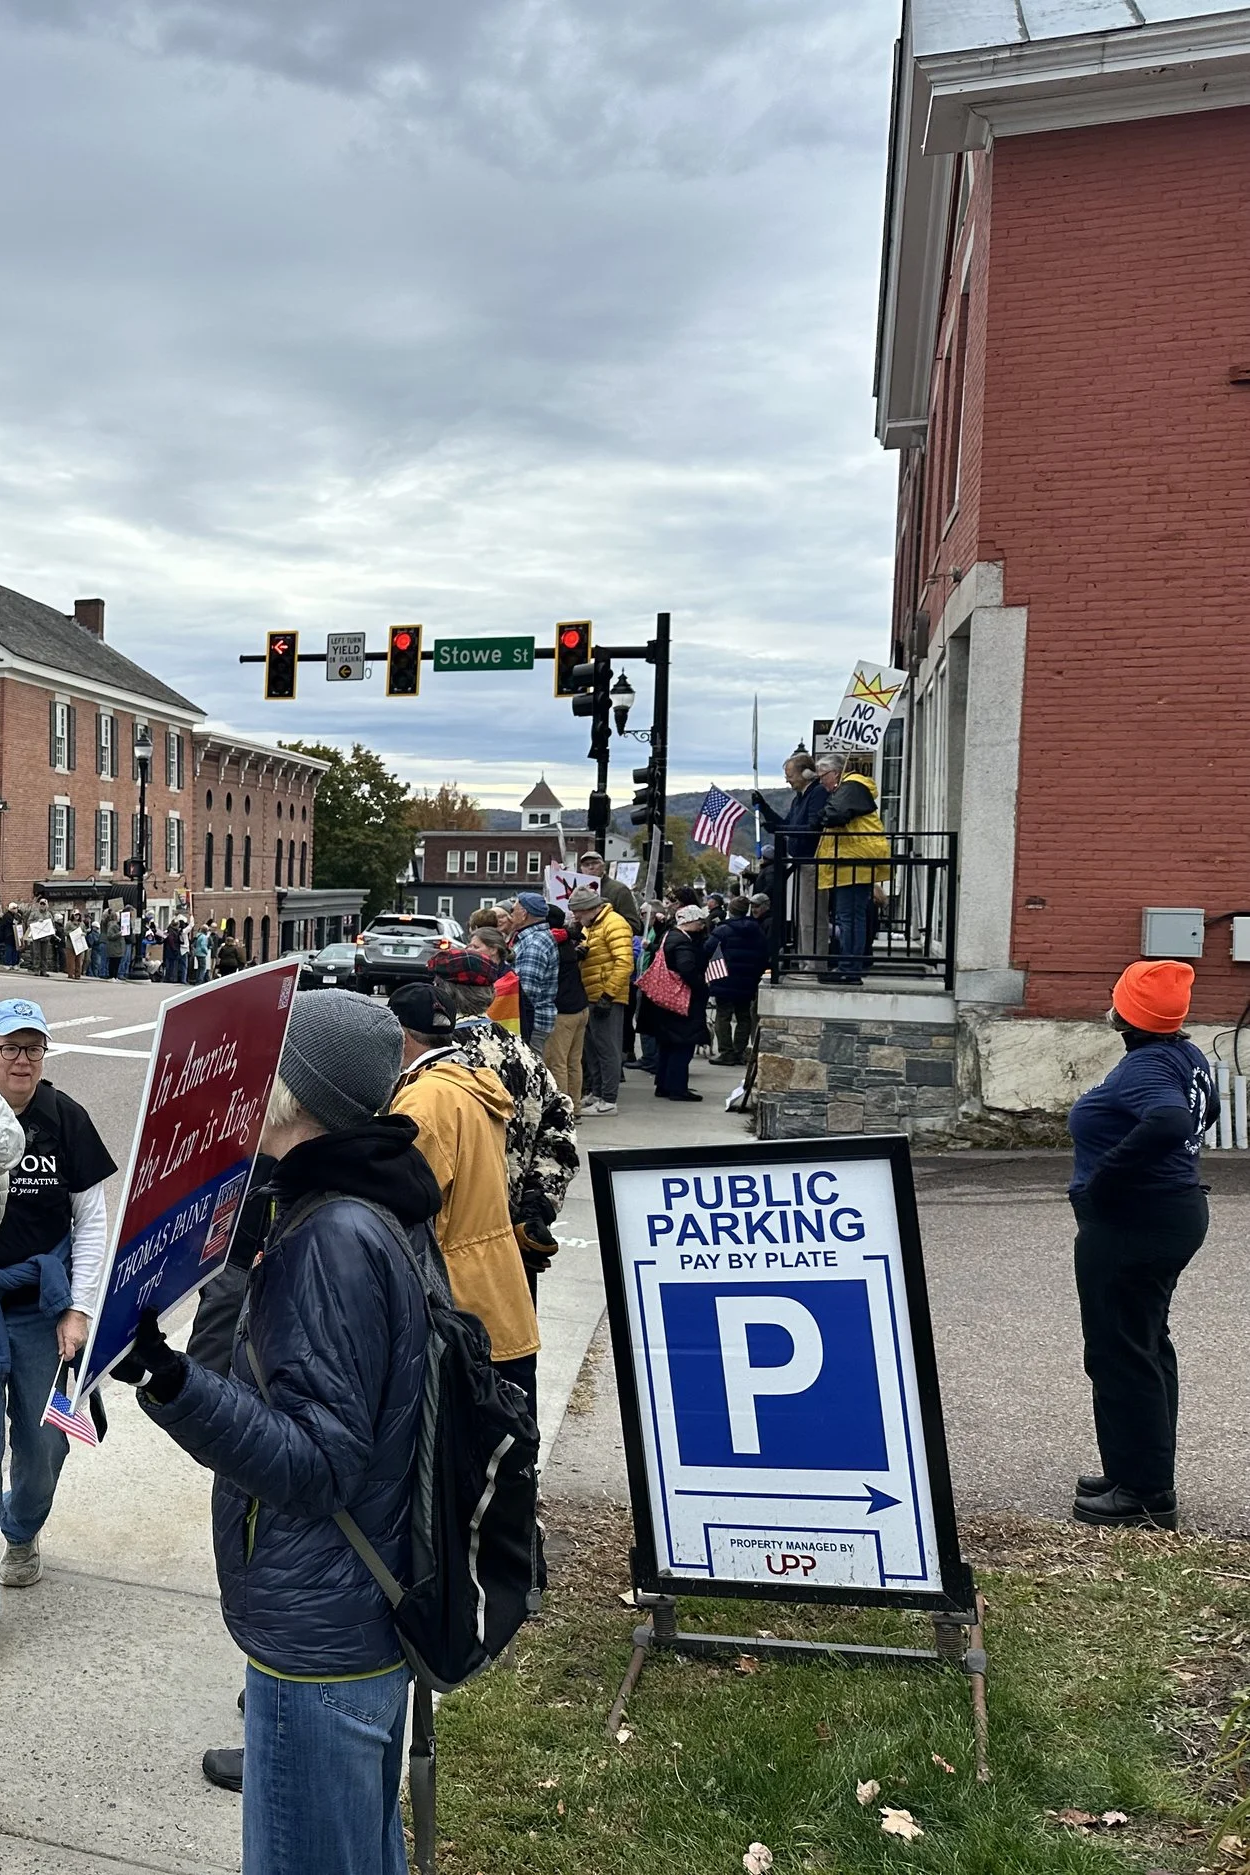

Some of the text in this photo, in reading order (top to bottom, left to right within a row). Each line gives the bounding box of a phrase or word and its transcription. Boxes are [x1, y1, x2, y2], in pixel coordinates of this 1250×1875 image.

[332, 645, 361, 655] YIELD
[439, 646, 529, 665] Stowe St
[851, 703, 875, 721] NO
[833, 717, 882, 746] KINGS
[150, 1032, 238, 1116] In America,
[131, 1138, 161, 1203] the
[159, 1121, 200, 1181] Law
[199, 1108, 219, 1154] is
[217, 1073, 272, 1147] King!
[21, 1154, 57, 1173] ON
[17, 1188, 40, 1196] years
[662, 1170, 840, 1211] PUBLIC
[647, 1207, 866, 1247] PARKING
[113, 1222, 171, 1296] THOMAS
[169, 1193, 213, 1246] PAINE
[680, 1250, 839, 1270] PAY BY PLATE
[135, 1255, 169, 1311] 1776
[715, 1296, 824, 1455] P
[730, 1538, 854, 1553] PROPERTY MANAGED BY
[765, 1553, 817, 1577] UPP
